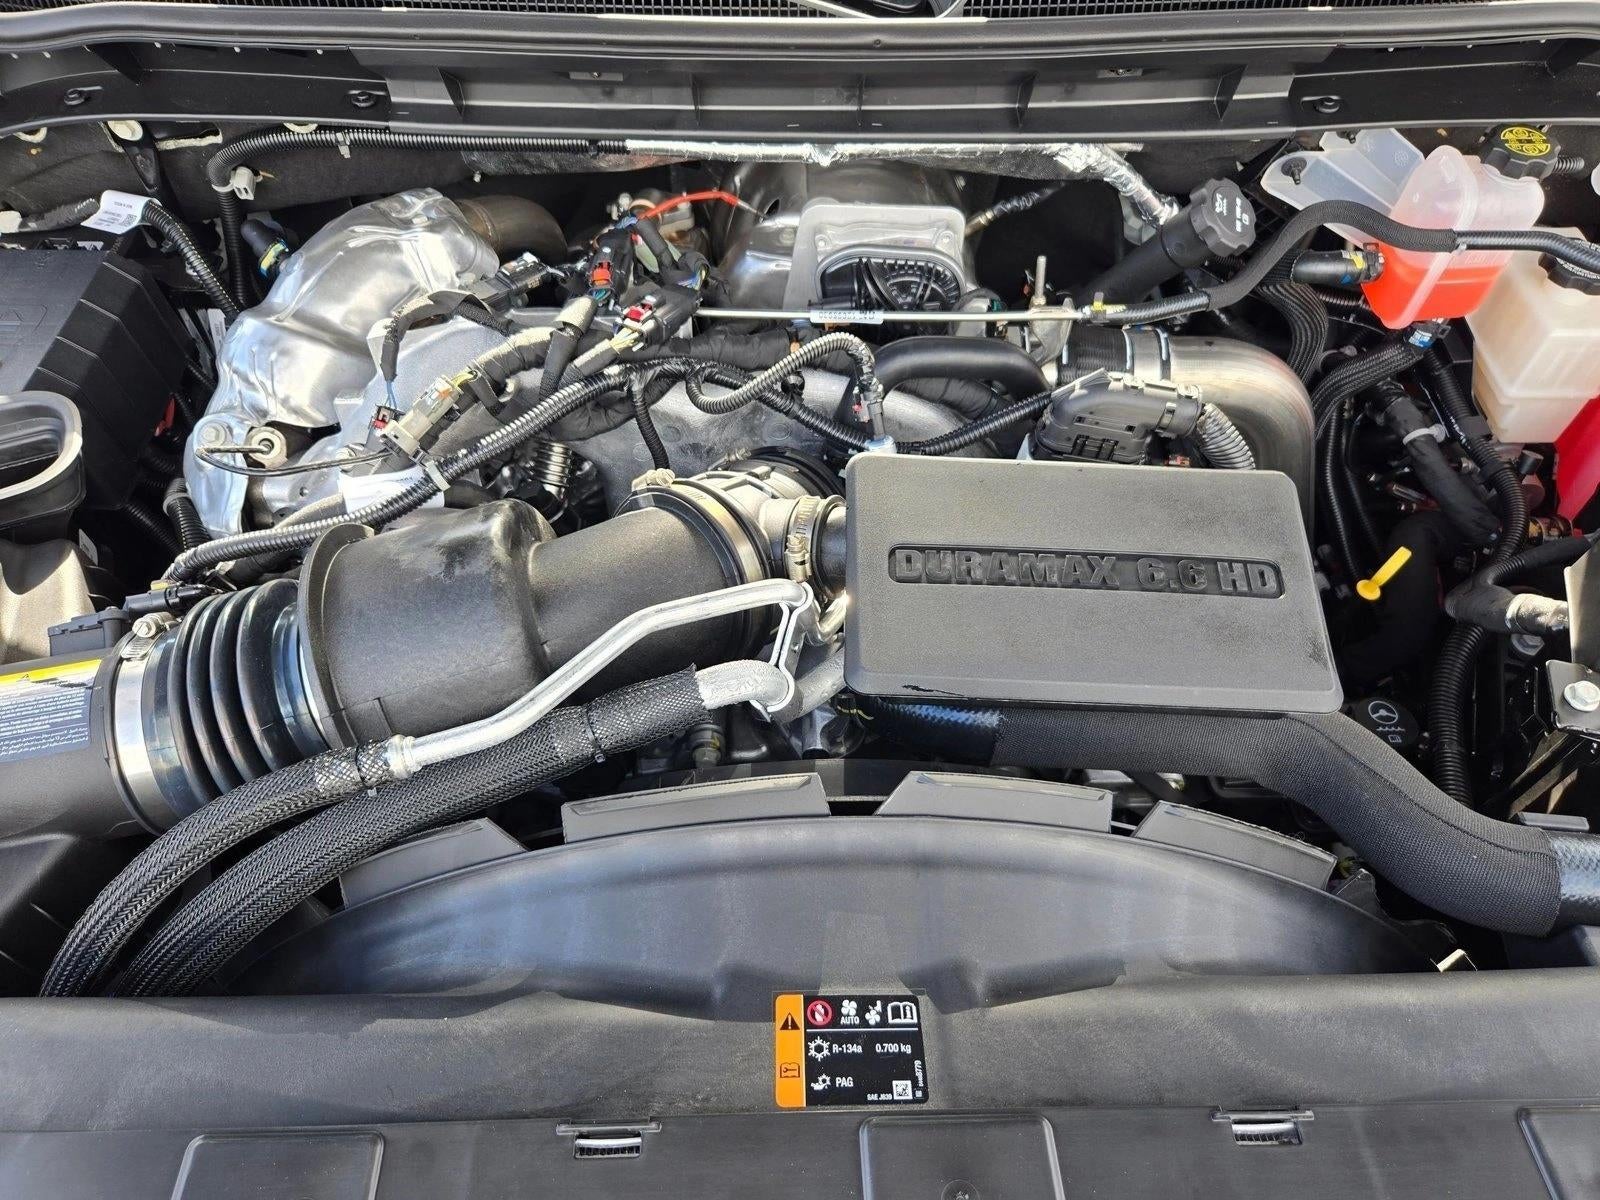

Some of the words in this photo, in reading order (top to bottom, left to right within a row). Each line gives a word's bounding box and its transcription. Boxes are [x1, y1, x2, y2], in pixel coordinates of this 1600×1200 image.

[895, 549, 1120, 587] DURAMAX
[1136, 556, 1208, 591] 6.6
[1217, 561, 1279, 595] HD
[832, 1044, 862, 1053] R-134a
[875, 1043, 899, 1053] 0.700
[900, 1044, 911, 1054] kg
[836, 1077, 853, 1087] PAG
